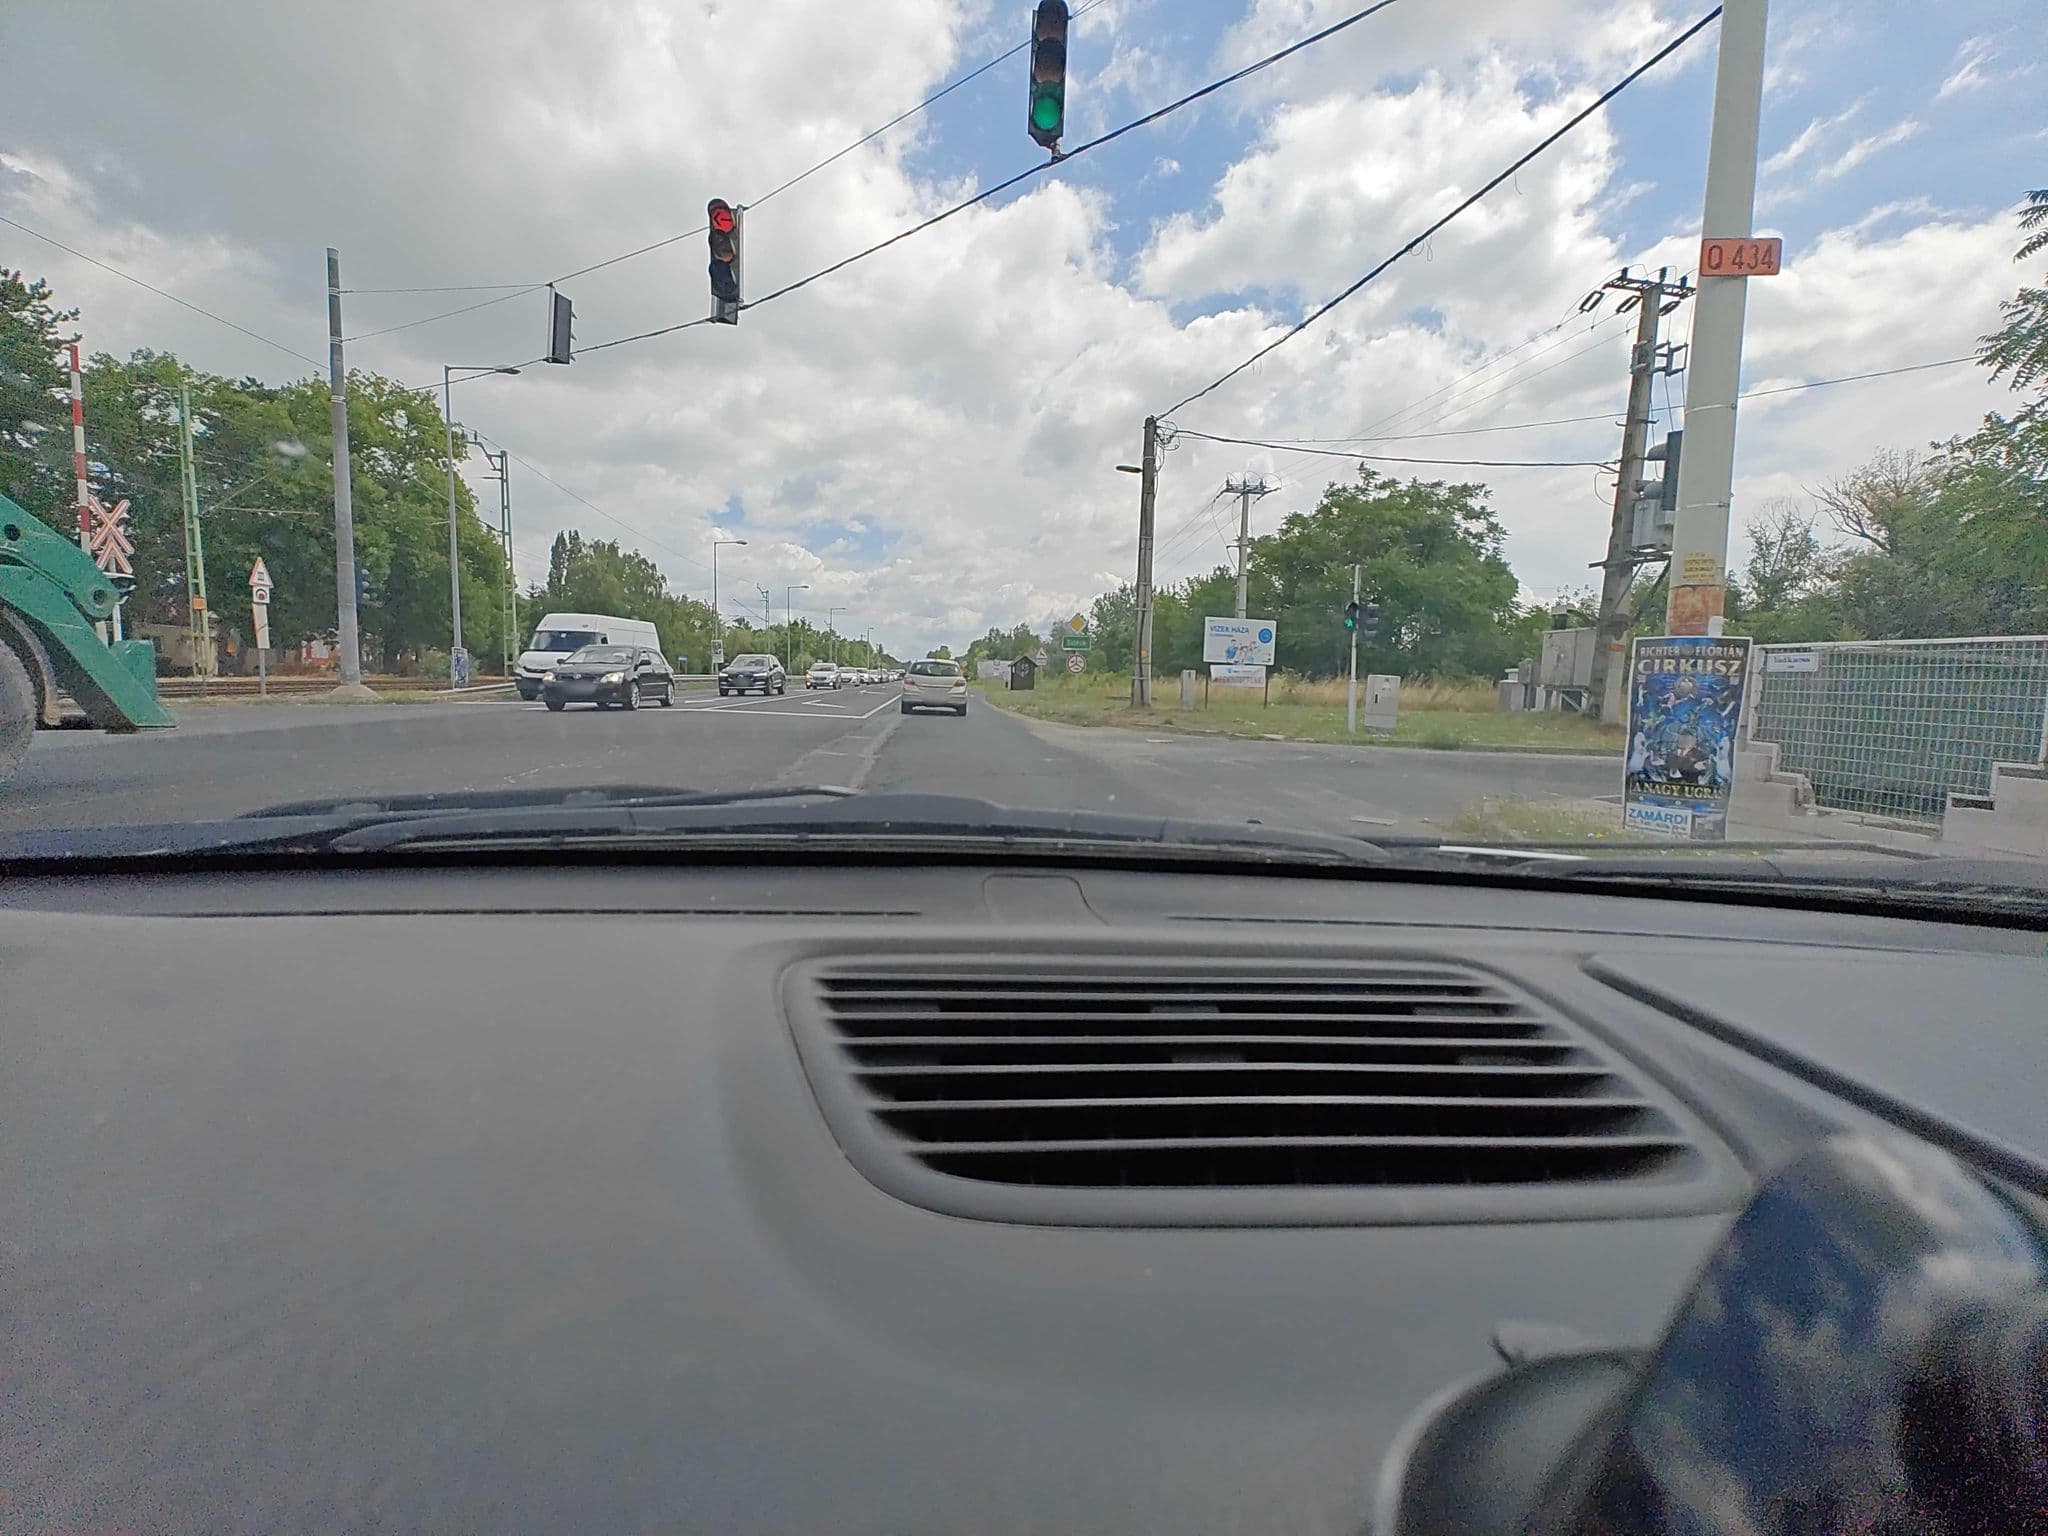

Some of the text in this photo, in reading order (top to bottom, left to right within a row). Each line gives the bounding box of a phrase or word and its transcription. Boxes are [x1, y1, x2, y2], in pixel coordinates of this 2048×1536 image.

[1731, 244, 1773, 270] 434
[1640, 646, 1680, 657] RICHTER
[1637, 659, 1742, 675] CIRKUSZ
[1632, 782, 1642, 792] A
[1643, 782, 1681, 797] NAGY
